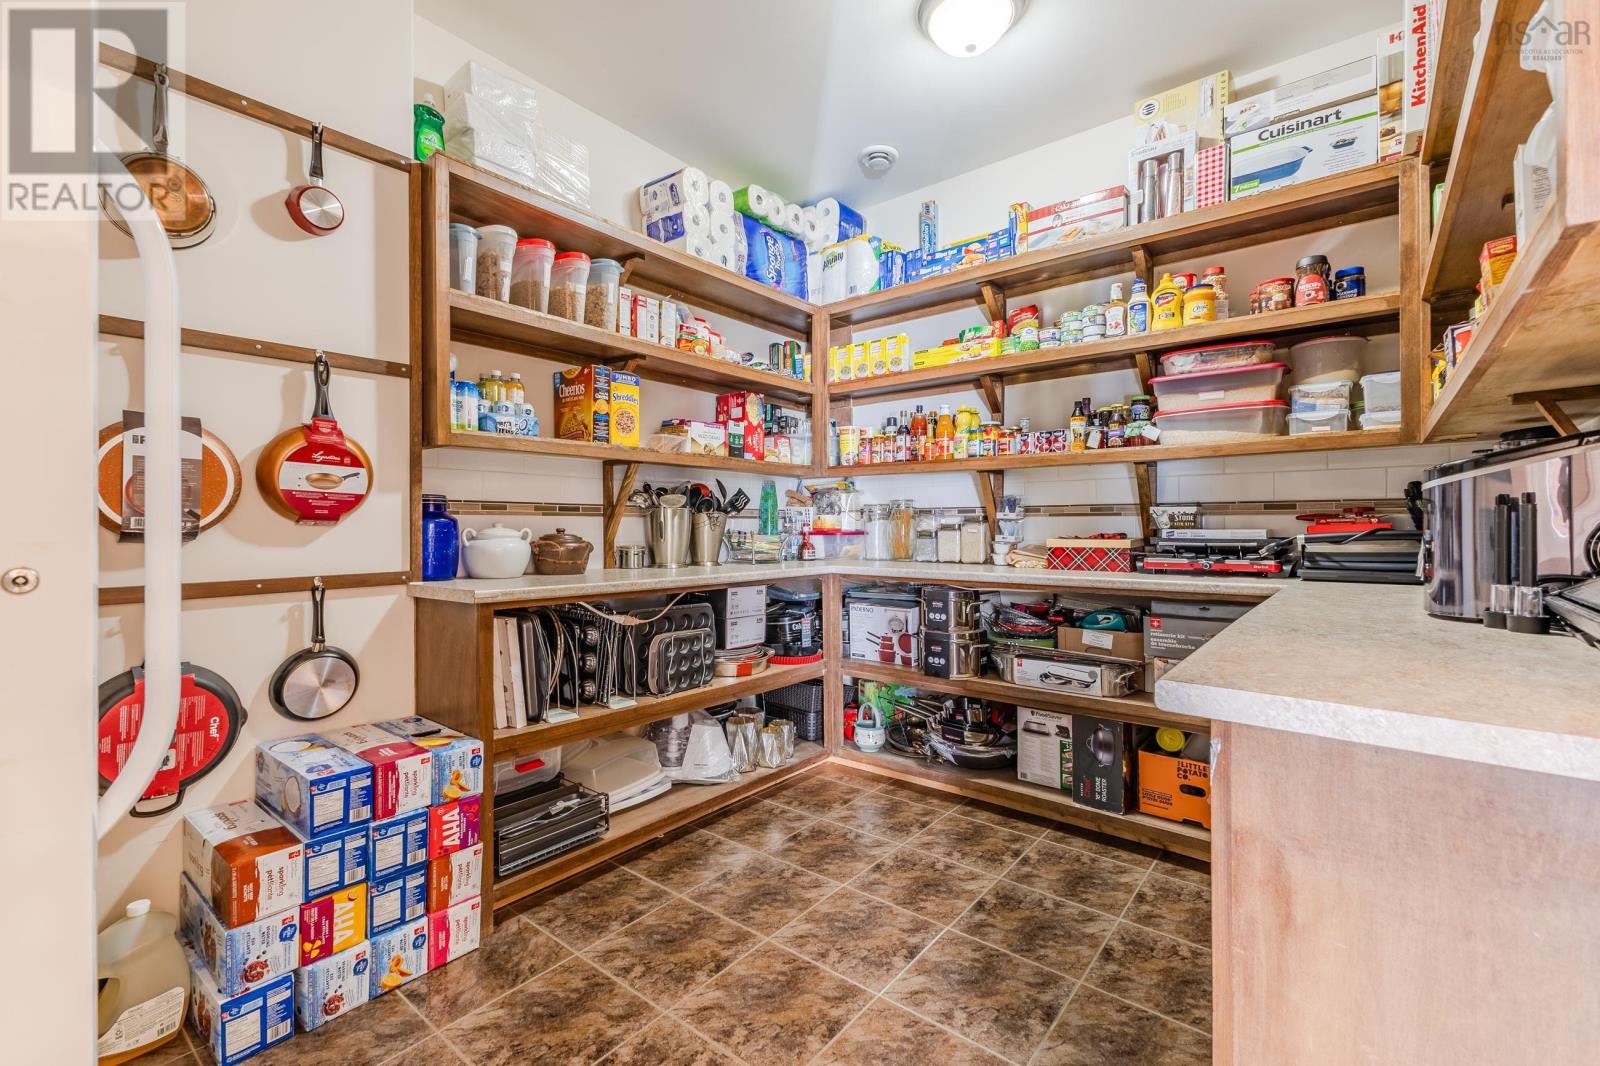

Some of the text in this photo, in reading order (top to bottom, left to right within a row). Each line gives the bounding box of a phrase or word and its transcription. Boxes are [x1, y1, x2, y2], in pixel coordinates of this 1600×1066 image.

[1411, 4, 1427, 107] KitchenAid
[1258, 108, 1342, 142] Cuisinart
[765, 235, 779, 282] Sponge
[559, 383, 586, 399] Cheerios
[615, 373, 636, 382] JUMBO
[209, 716, 219, 737] Chef
[1177, 767, 1208, 779] POTATO
[1181, 761, 1208, 772] LITTLE
[442, 807, 461, 847] AHA
[276, 866, 285, 896] sparkling
[333, 901, 355, 946] AHA
